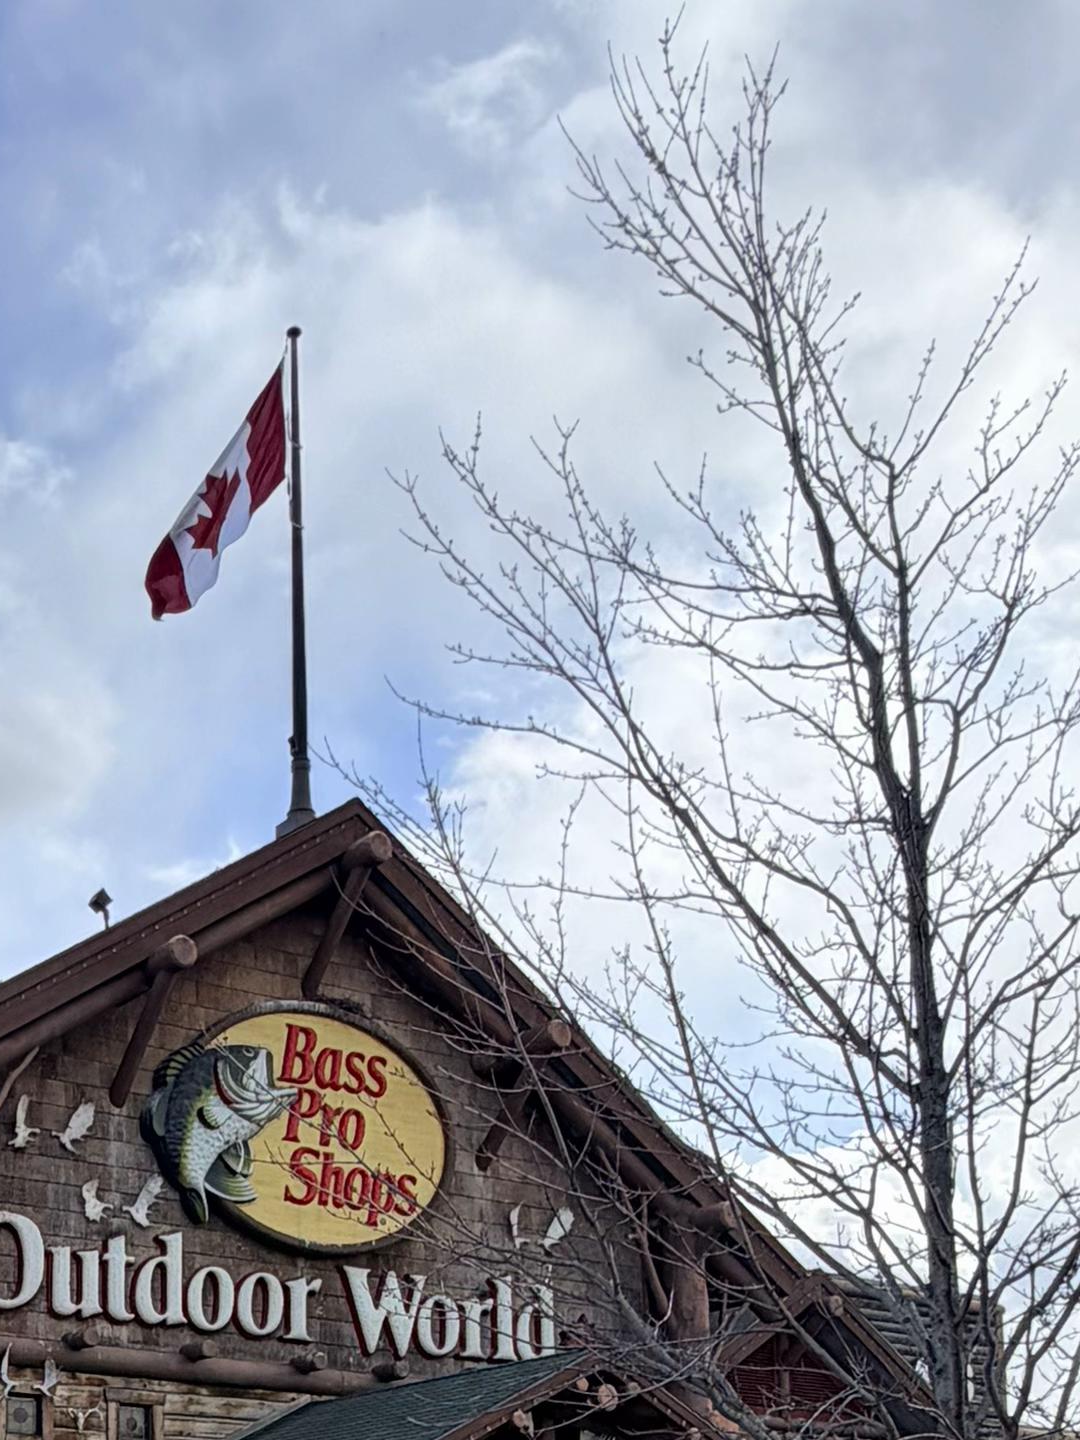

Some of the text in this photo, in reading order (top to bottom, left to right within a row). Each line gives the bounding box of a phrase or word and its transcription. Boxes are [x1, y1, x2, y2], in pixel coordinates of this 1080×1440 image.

[276, 1023, 387, 1098] Bass
[281, 1087, 366, 1151] Pro
[283, 1147, 418, 1227] Shops
[338, 1263, 556, 1362] World
